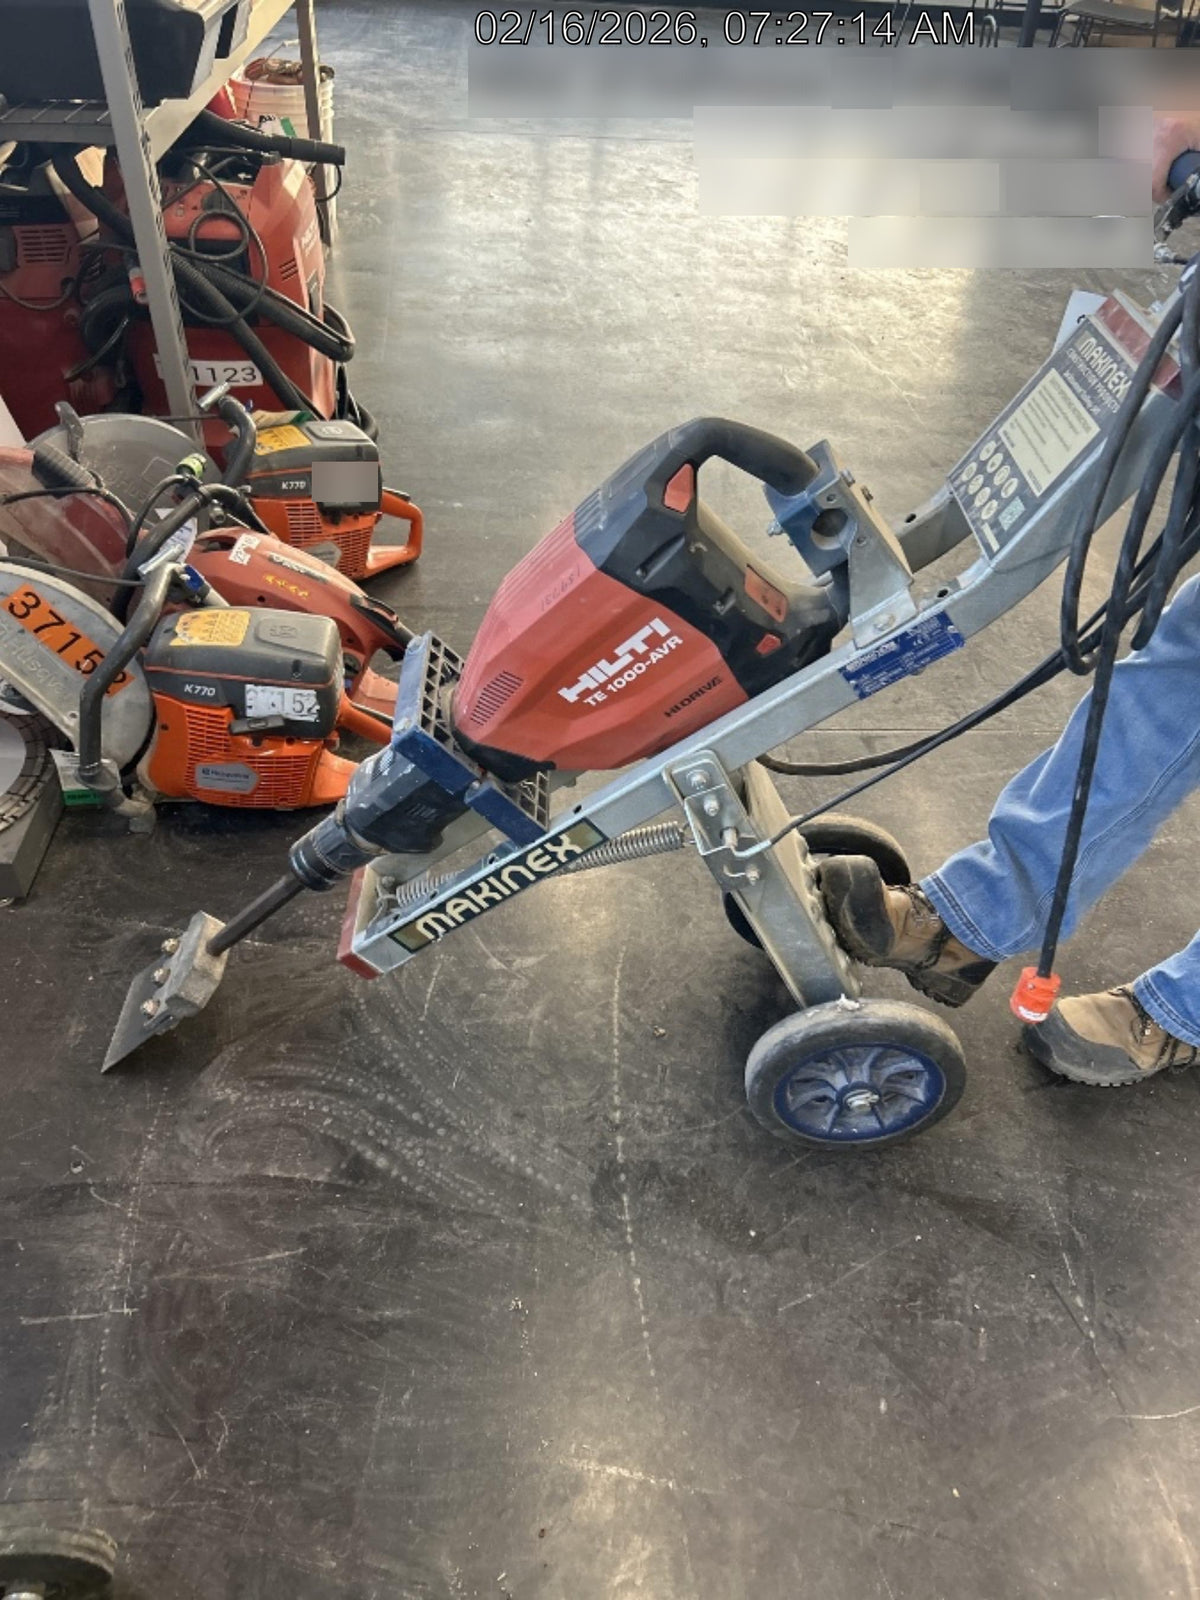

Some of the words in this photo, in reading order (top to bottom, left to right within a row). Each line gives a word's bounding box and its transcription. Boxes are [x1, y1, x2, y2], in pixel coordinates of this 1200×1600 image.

[1079, 337, 1132, 399] MAKINEX
[281, 480, 307, 490] K770
[184, 683, 216, 697] K770
[557, 617, 671, 703] HILTI
[583, 690, 608, 706] TE
[607, 635, 684, 693] 1000-AVR
[664, 675, 722, 717] HIDRIVE
[415, 833, 584, 941] MAKINEX
